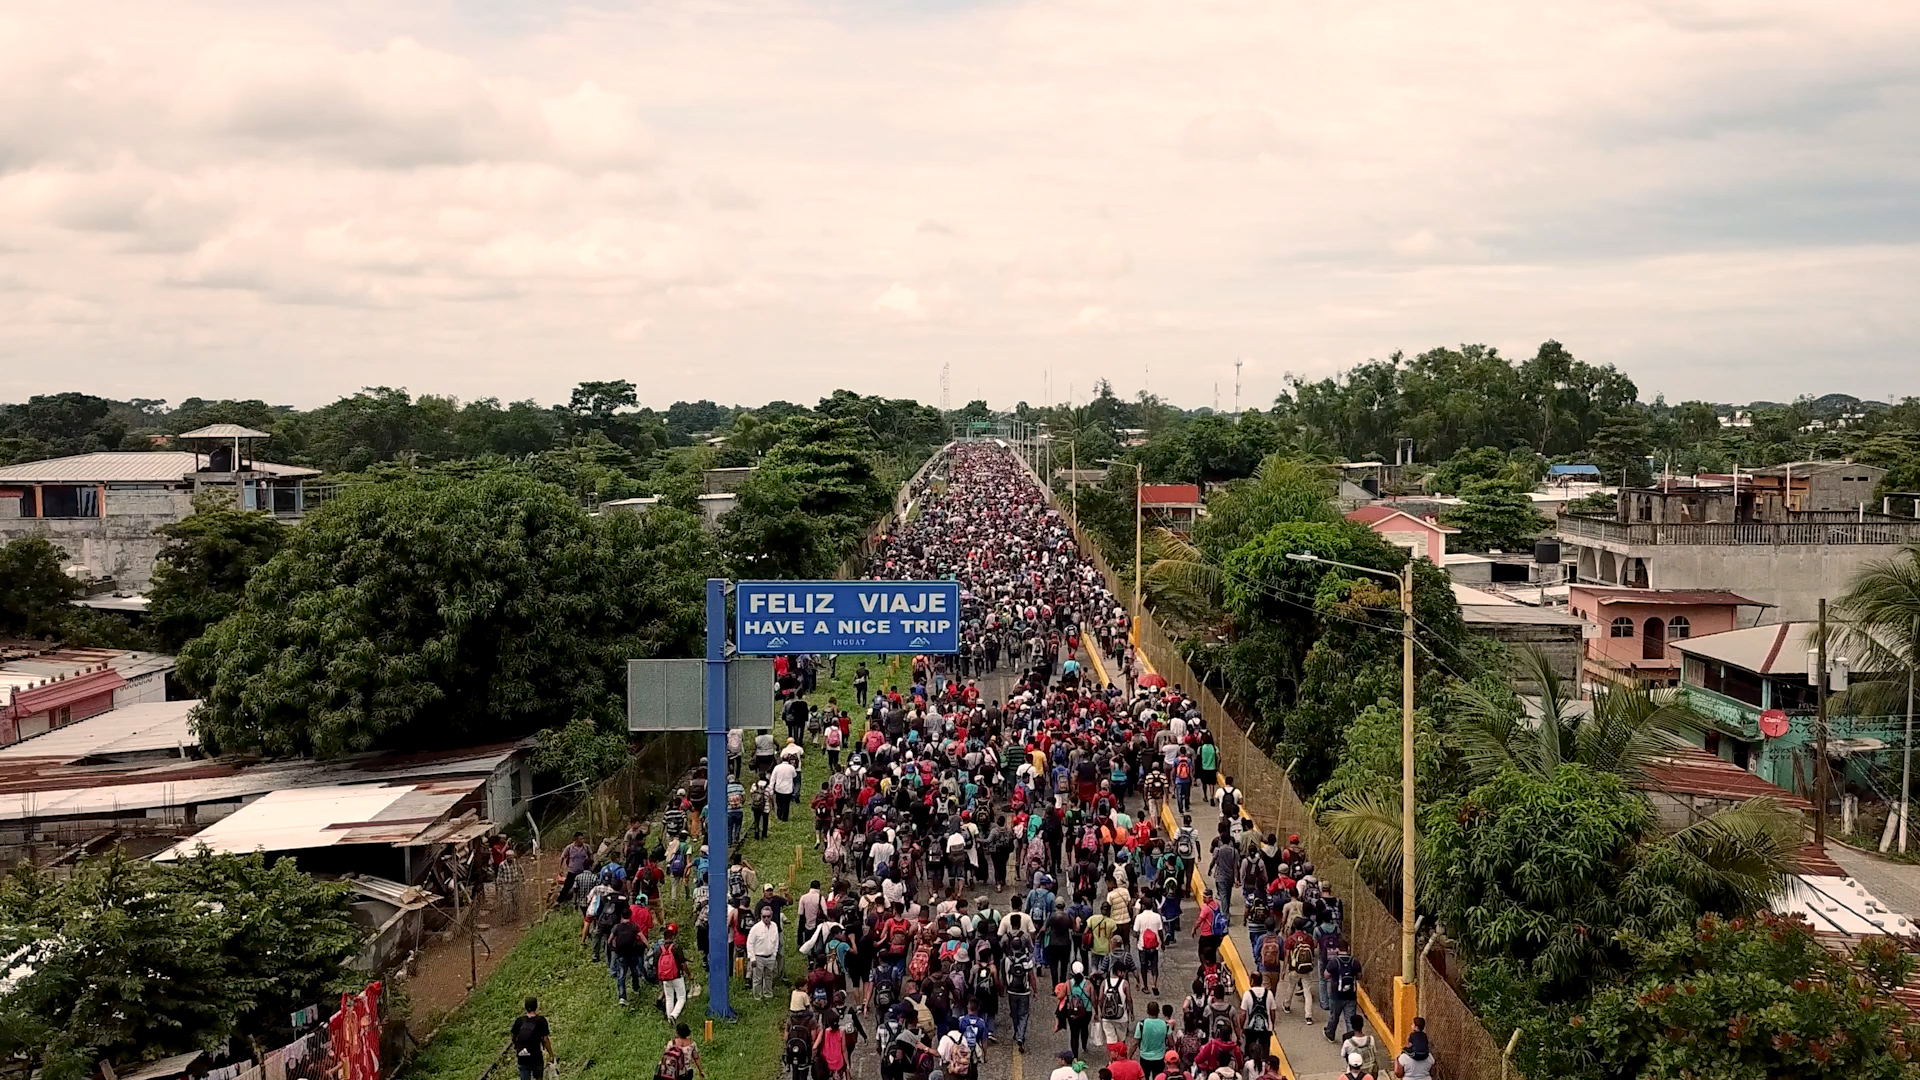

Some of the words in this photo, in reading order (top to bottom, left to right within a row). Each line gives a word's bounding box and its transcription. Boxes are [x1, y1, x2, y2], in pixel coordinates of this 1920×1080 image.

[750, 593, 834, 613] FELIZ
[858, 593, 946, 613] VIAJE
[745, 621, 805, 635] HAVE
[813, 621, 829, 634] A
[839, 620, 891, 634] NICE
[900, 620, 950, 634] TRIP
